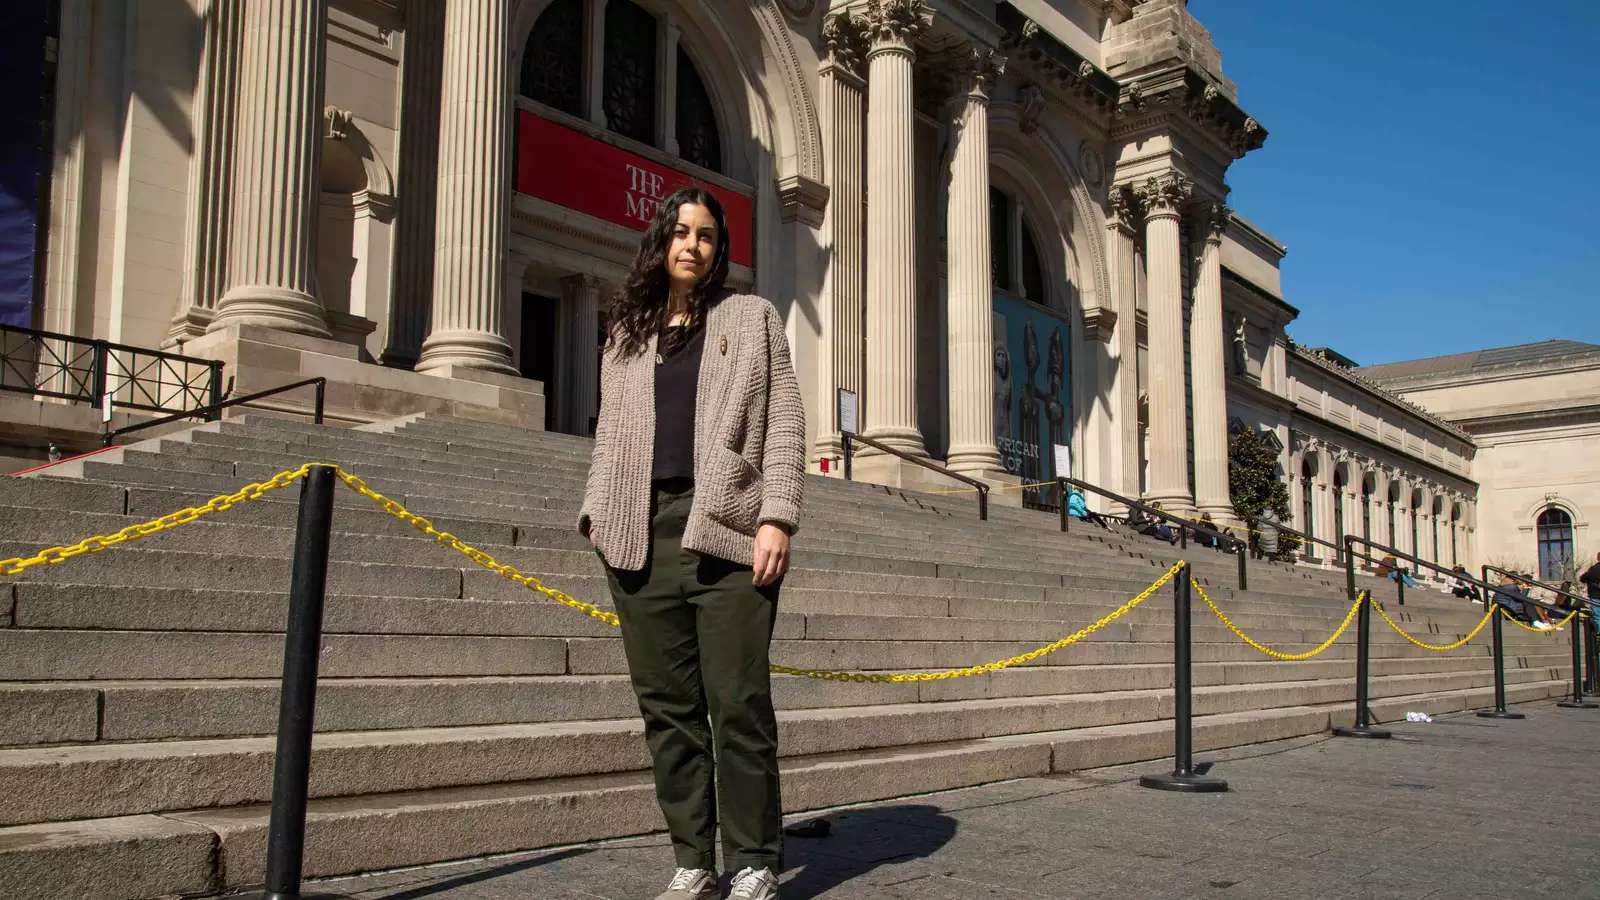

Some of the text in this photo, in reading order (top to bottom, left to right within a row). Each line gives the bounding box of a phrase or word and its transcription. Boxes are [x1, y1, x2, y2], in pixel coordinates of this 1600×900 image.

[626, 164, 664, 201] THE
[624, 190, 657, 223] ME
[997, 436, 1039, 459] FRICAN
